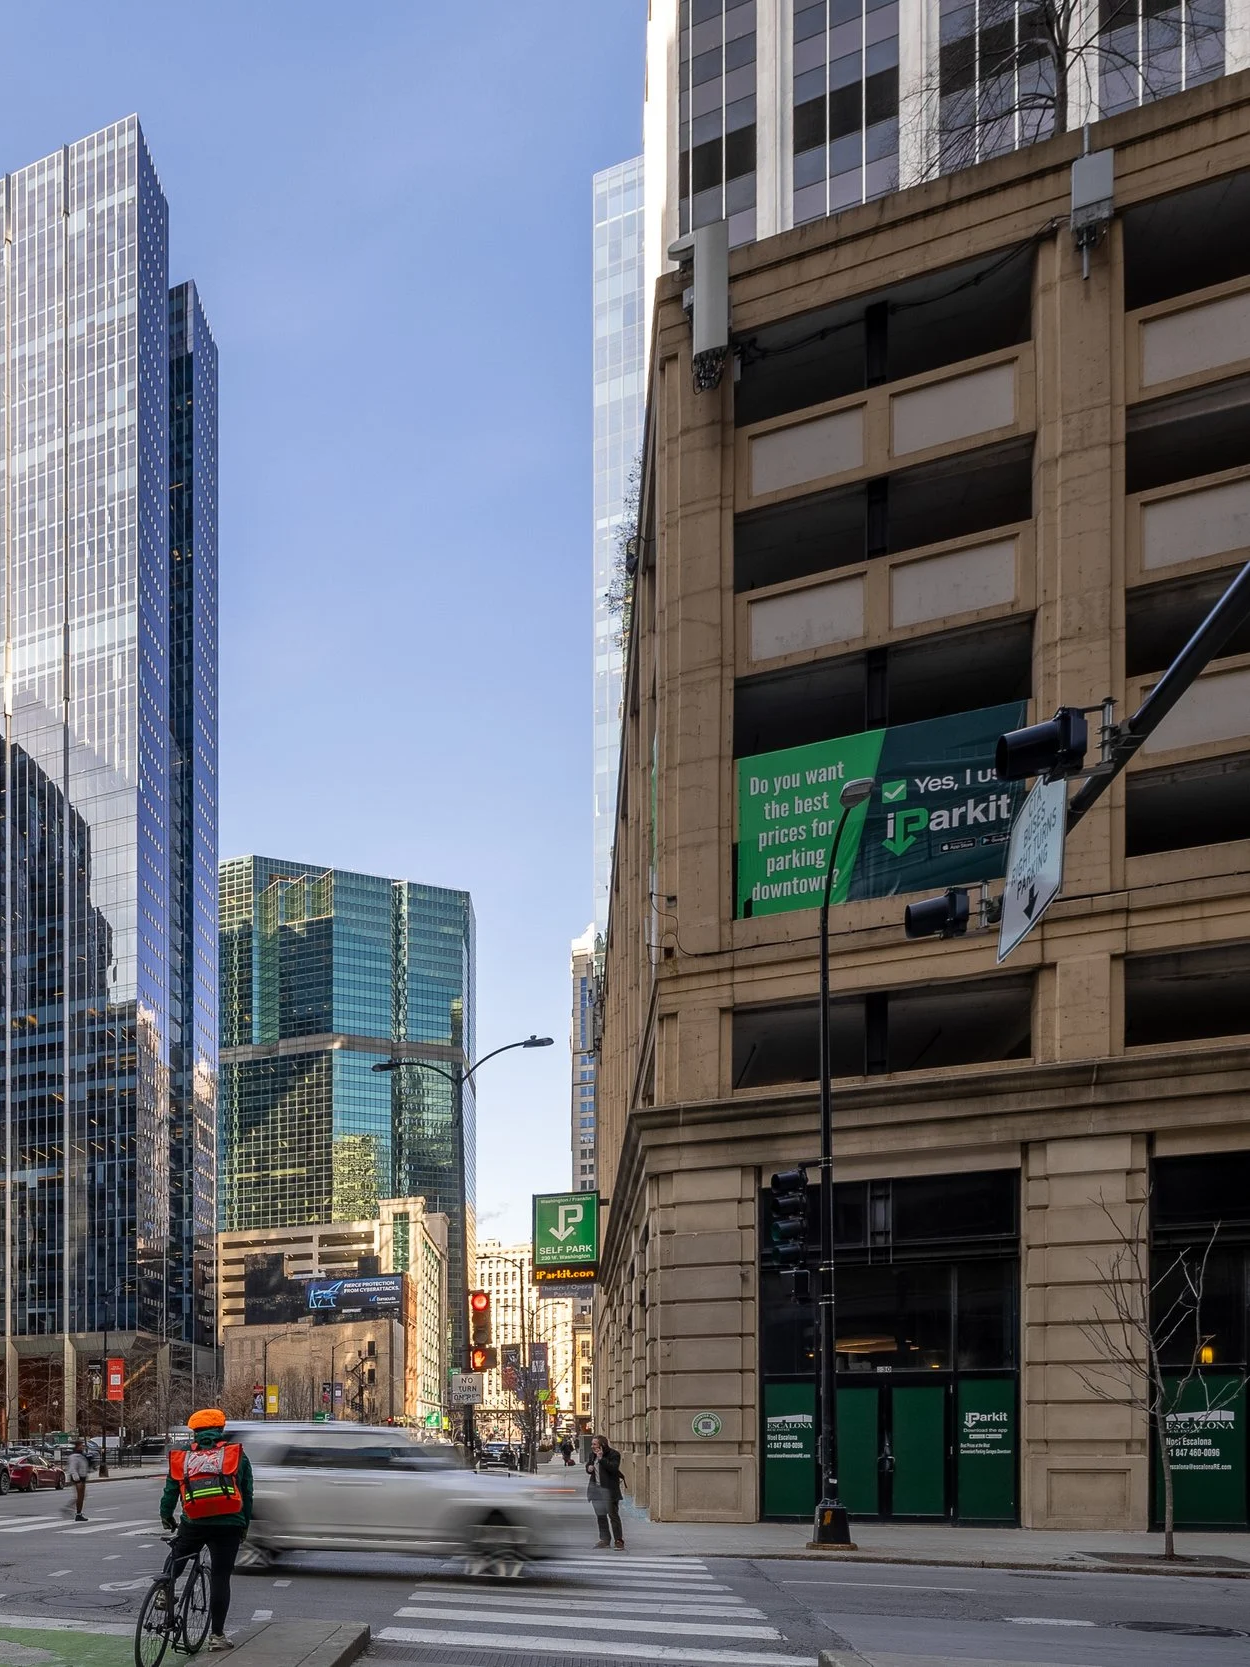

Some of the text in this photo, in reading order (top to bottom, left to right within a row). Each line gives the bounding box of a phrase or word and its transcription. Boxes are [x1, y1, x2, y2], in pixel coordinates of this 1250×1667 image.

[750, 761, 845, 796] Do you want
[914, 768, 998, 794] Yes, I us
[763, 791, 830, 821] the best
[1028, 785, 1043, 818] CTA
[758, 818, 835, 852] prices for
[882, 793, 1011, 857] iParkit
[1023, 800, 1046, 849] BUSES
[766, 848, 826, 877] parking
[1016, 842, 1049, 900] PARKING
[539, 1244, 593, 1255] SELF PARK
[536, 1269, 595, 1280] iParkit.com
[571, 1283, 592, 1291] Opera
[964, 1412, 1008, 1427] iParkit
[1166, 1421, 1234, 1430] ESCALONA
[1175, 1448, 1188, 1457] 847
[1189, 1448, 1220, 1457] 460-0096
[1182, 1437, 1212, 1446] Escalona
